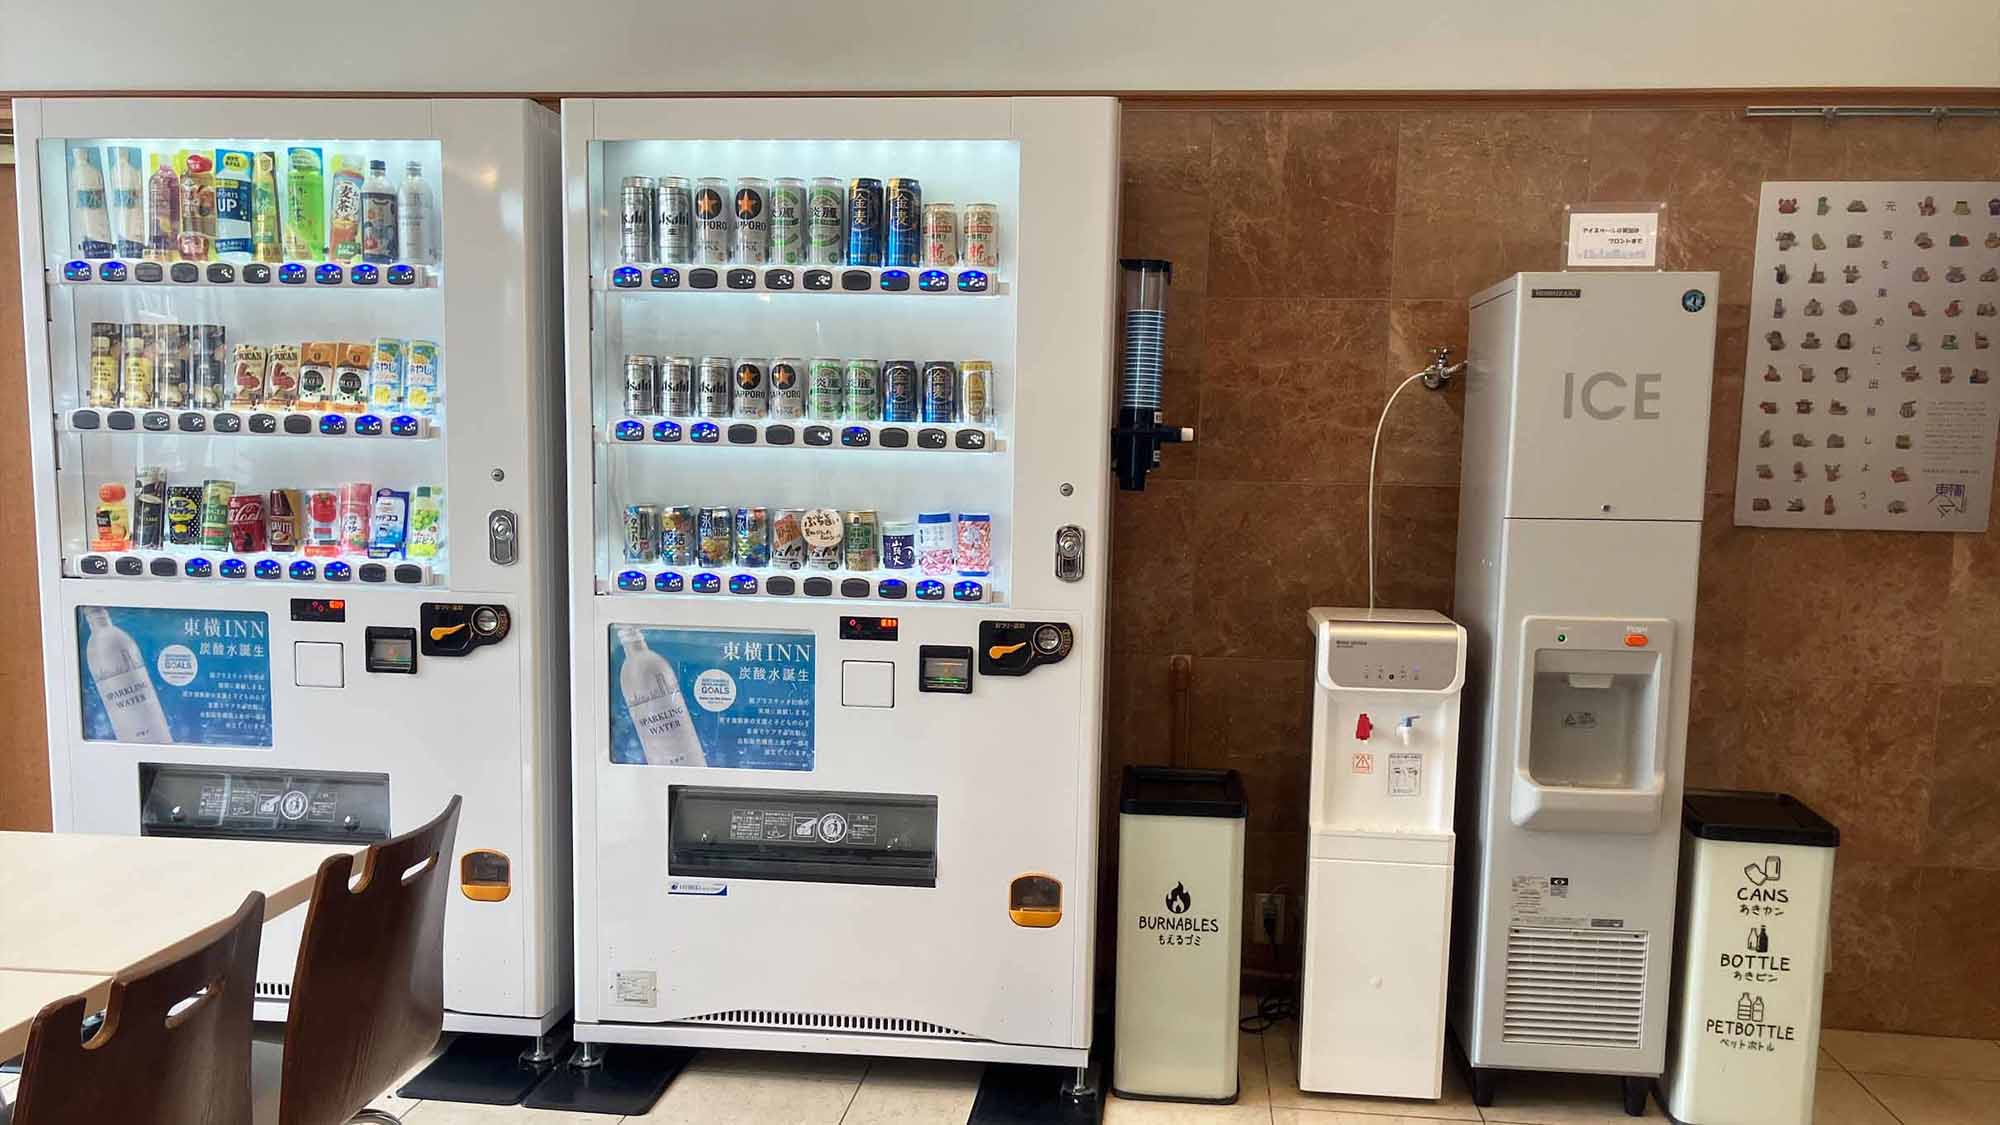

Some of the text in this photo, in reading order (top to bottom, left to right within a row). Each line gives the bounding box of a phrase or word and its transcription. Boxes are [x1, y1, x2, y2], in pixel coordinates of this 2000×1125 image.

[217, 199, 237, 213] UP
[337, 185, 356, 213] 麦茶
[1563, 371, 1662, 421] ICE
[184, 618, 266, 639] 東横INN
[199, 641, 266, 658] 炭酸水誕生
[723, 640, 811, 664] 東横INN
[738, 667, 810, 683] 炭酸水誕生
[701, 686, 731, 696] GOALS
[639, 706, 684, 728] SPARKLING
[648, 720, 681, 737] WATER
[1736, 886, 1790, 904] CANS
[1738, 903, 1785, 917] あきカン
[1138, 915, 1219, 932] BURNABLES
[1159, 934, 1201, 946] もえるゴミ
[1719, 952, 1792, 972] BOTTLE
[1732, 970, 1779, 983] あきビン
[1705, 1018, 1796, 1042] PETBOTTLE
[1719, 1038, 1777, 1053] ペットボトル
